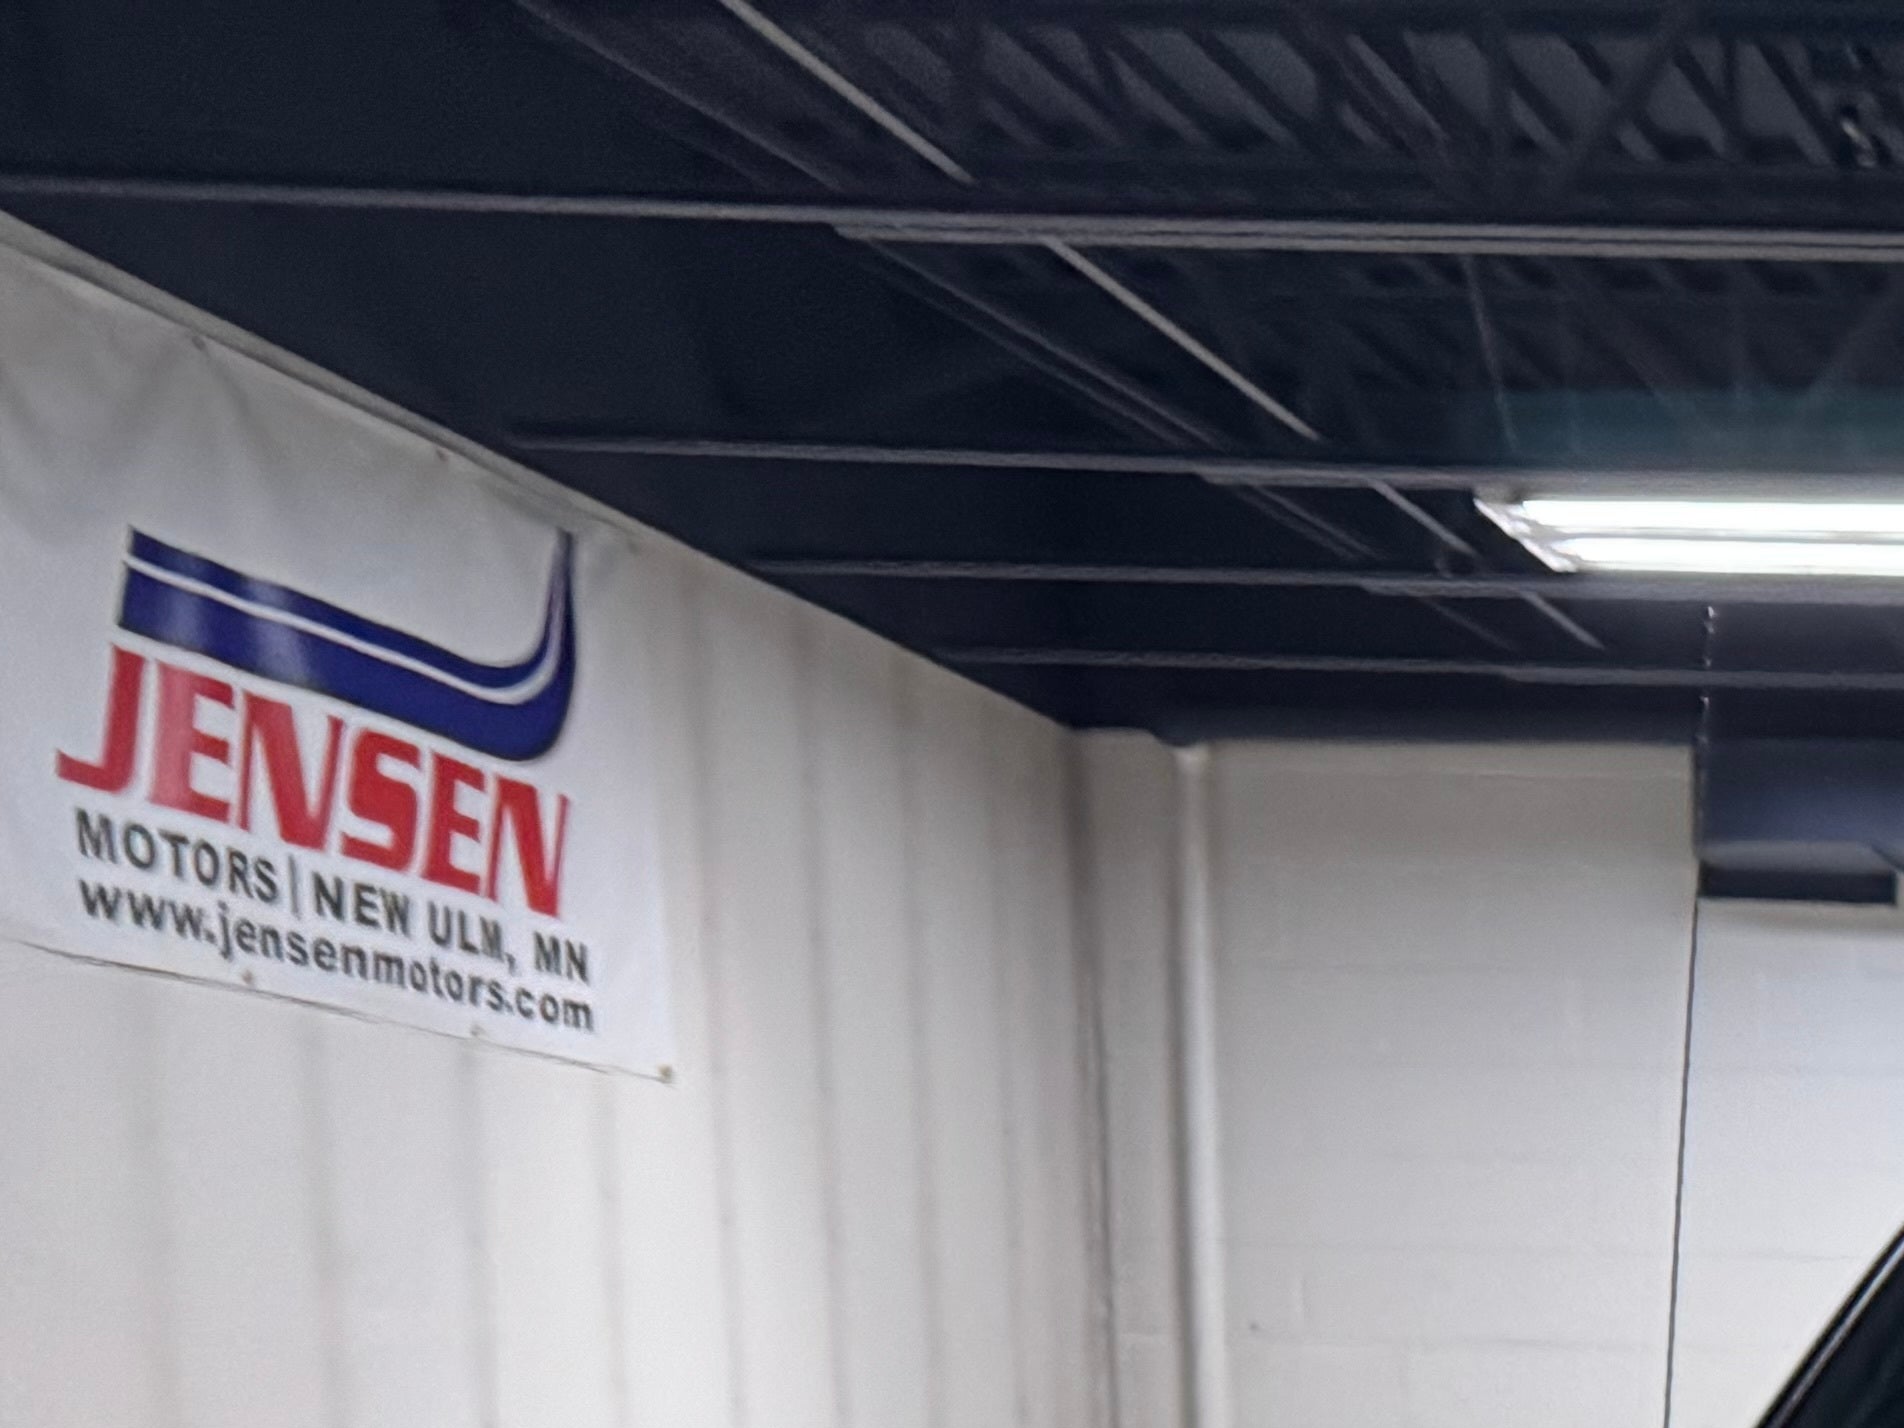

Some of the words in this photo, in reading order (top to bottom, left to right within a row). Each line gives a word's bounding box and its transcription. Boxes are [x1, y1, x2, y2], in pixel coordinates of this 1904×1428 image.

[56, 643, 570, 918] JENSEN
[75, 807, 279, 904] MOTORS
[312, 870, 411, 938] NEW
[427, 900, 516, 975] ULM,
[533, 931, 590, 985] MN
[78, 878, 595, 1032] www.jensenmotors.com
